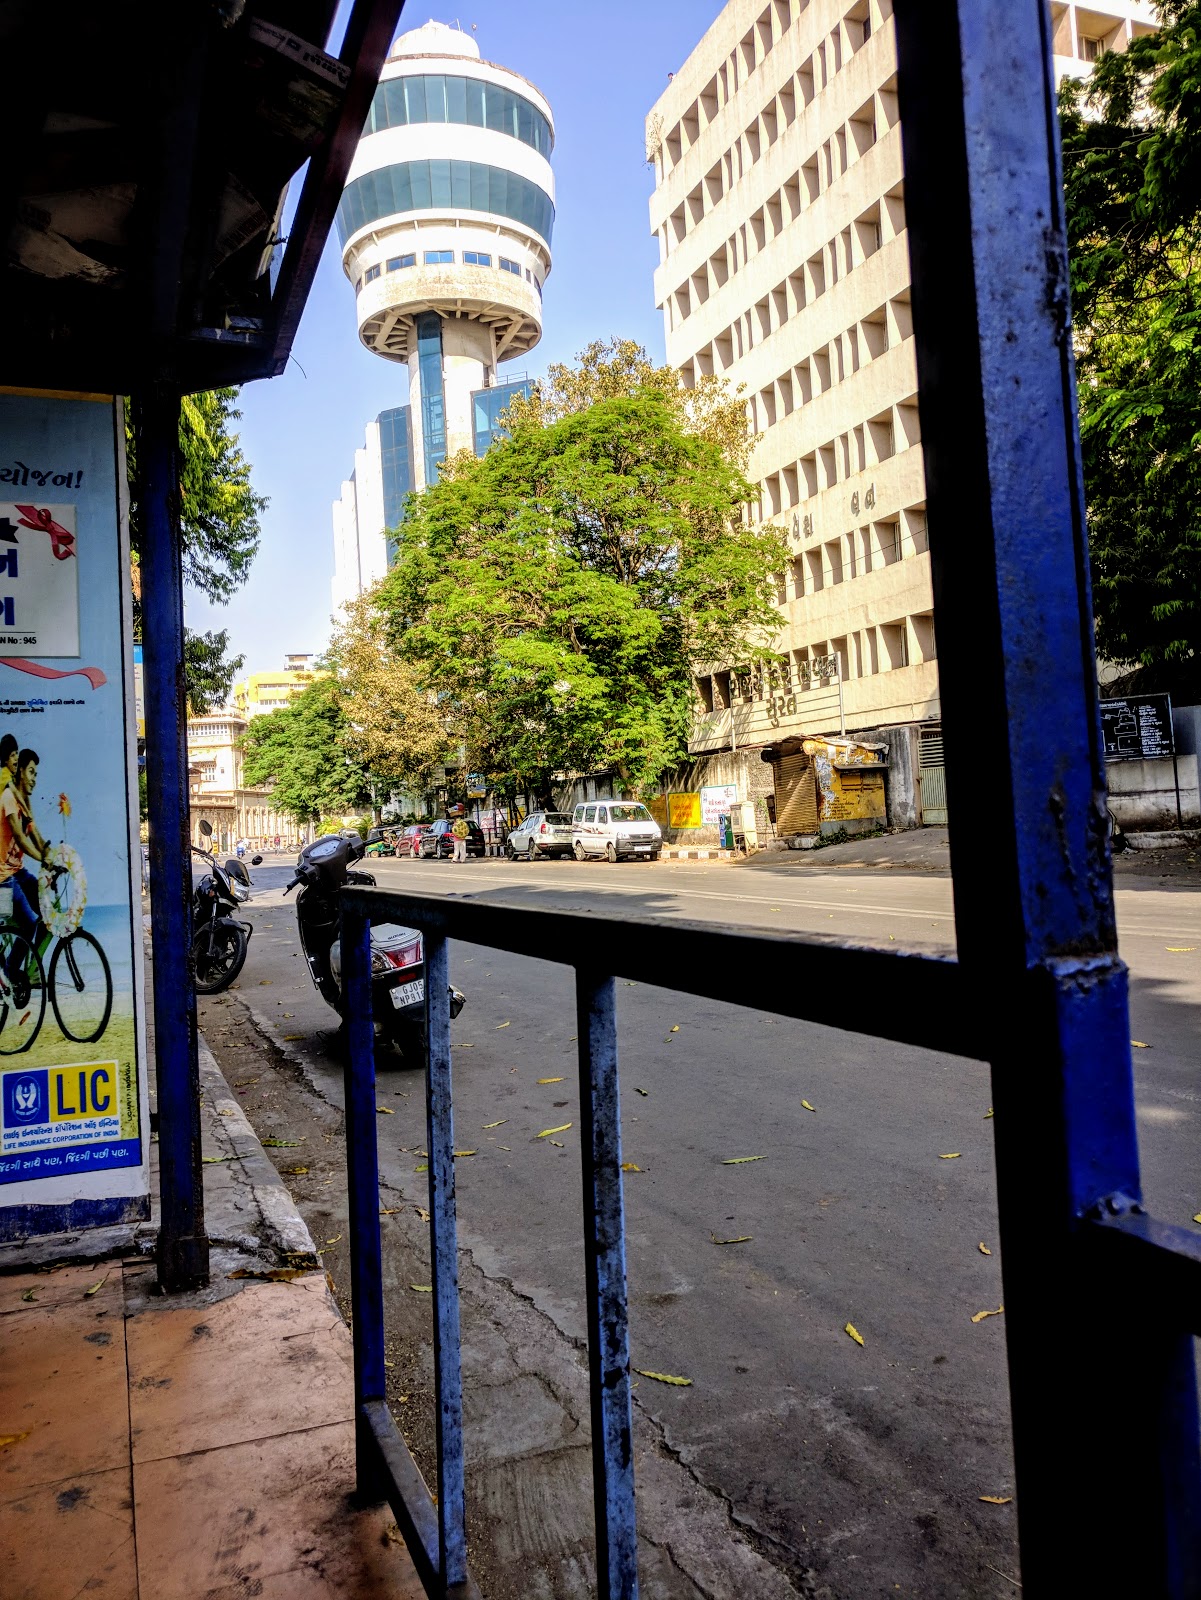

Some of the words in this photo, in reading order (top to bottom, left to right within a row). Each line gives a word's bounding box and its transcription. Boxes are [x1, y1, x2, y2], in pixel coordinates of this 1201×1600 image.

[766, 693, 798, 728] સુરત
[402, 980, 424, 995] GJ05
[56, 1069, 110, 1115] LIC
[4, 1142, 17, 1150] LIFE
[18, 1138, 51, 1148] INSURANCE
[53, 1131, 93, 1142] CORPORATION
[103, 1129, 119, 1137] INDIA
